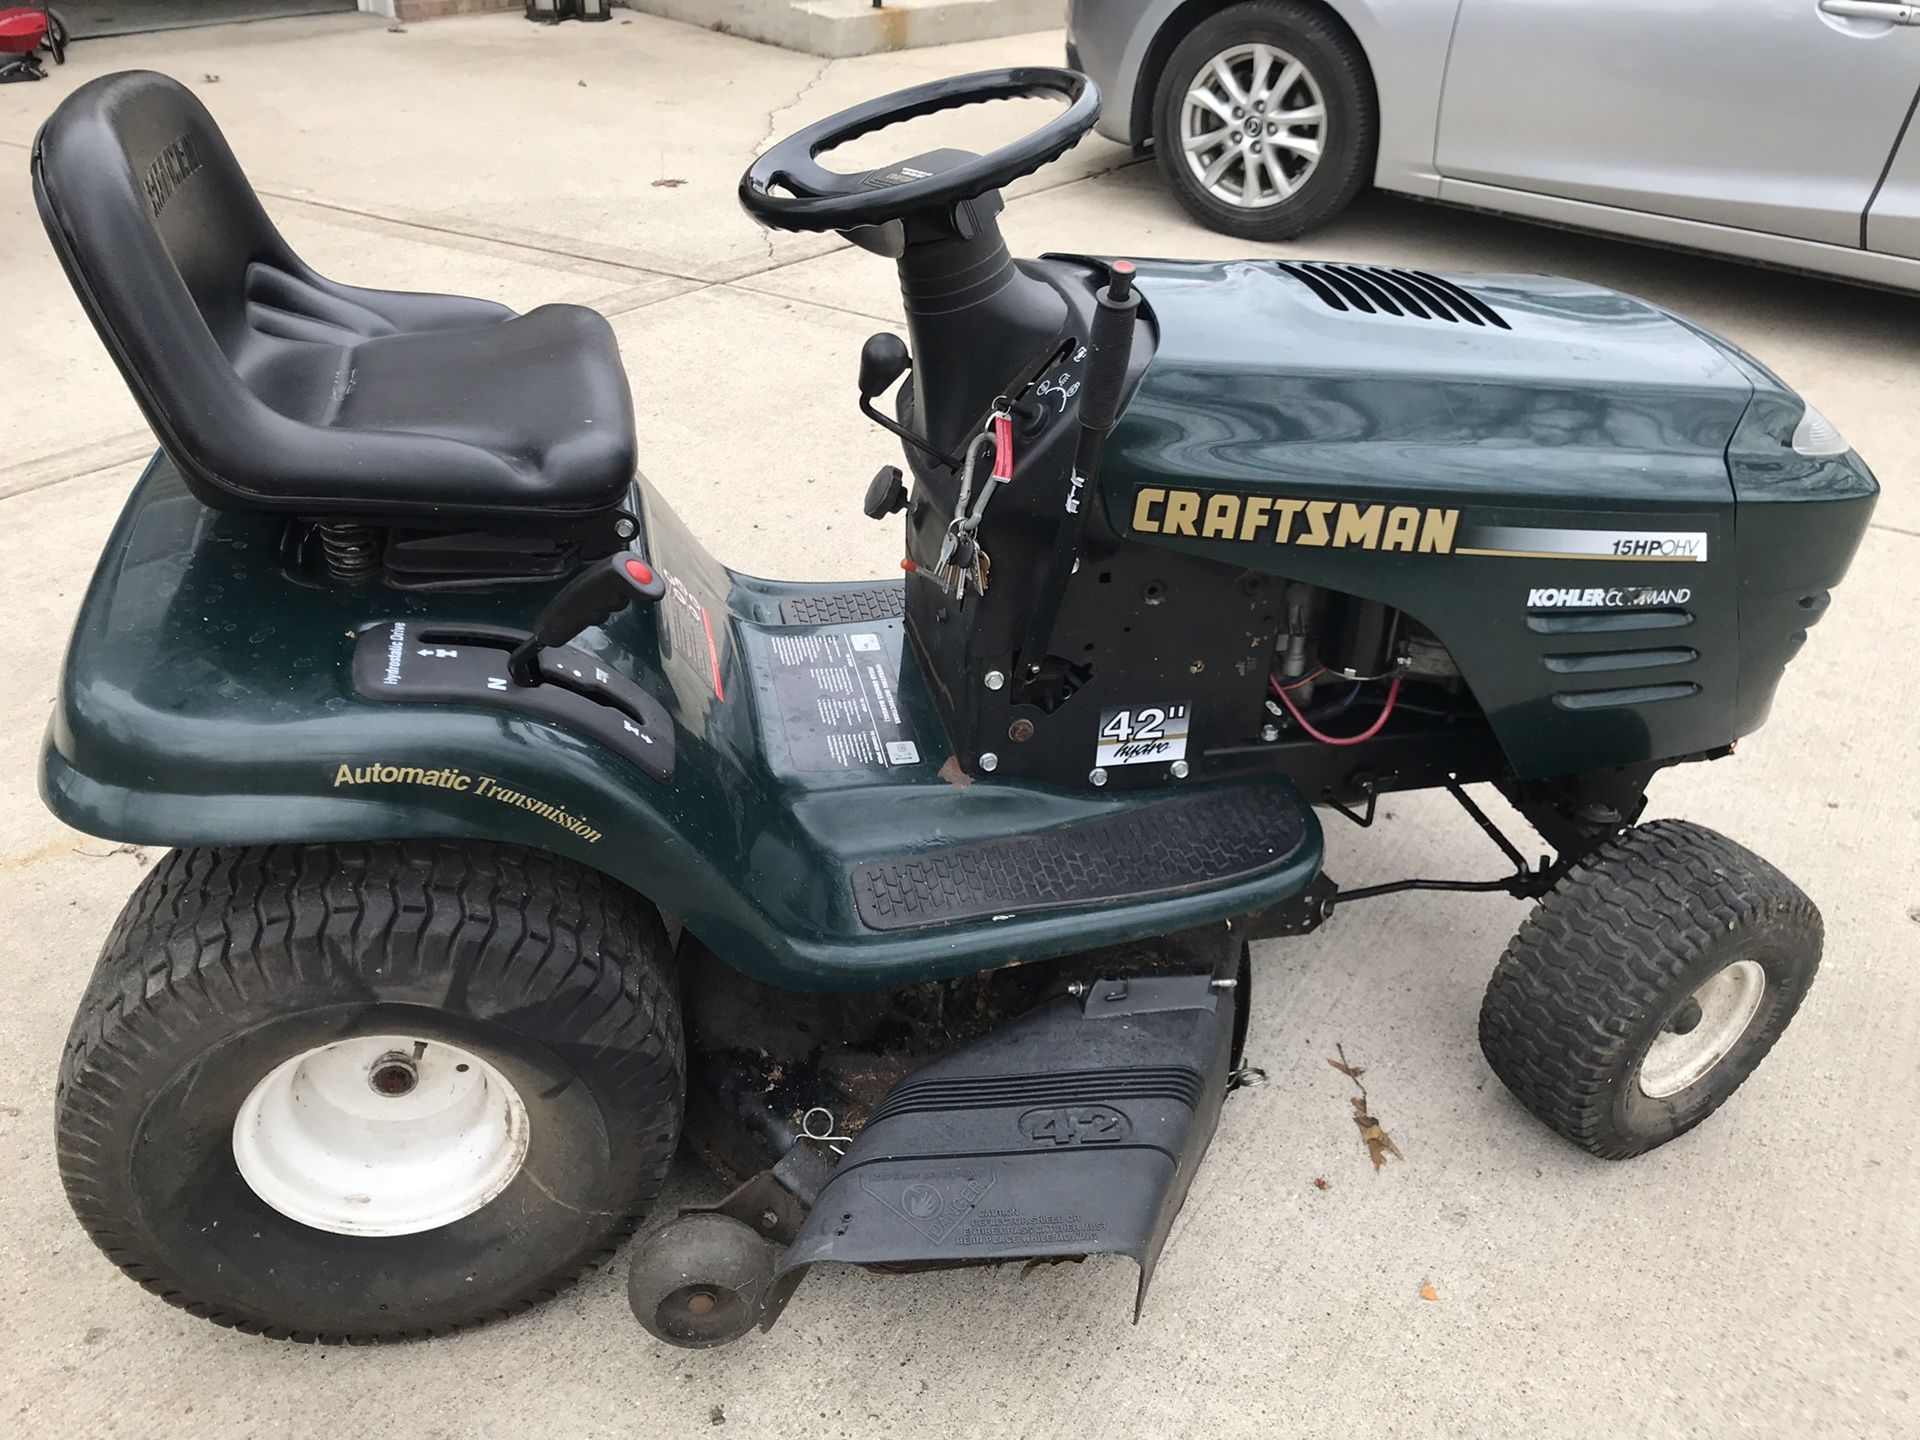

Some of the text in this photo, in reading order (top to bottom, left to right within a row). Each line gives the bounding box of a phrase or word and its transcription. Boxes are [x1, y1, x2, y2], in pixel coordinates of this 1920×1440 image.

[1132, 488, 1459, 554] CRAFTSMAN
[383, 622, 406, 685] Hydrostatic Drive
[487, 677, 508, 691] N
[1102, 704, 1185, 743] 42"
[1113, 740, 1169, 763] hydro
[334, 763, 603, 843] Automatic Transmission
[927, 1179, 985, 1238] DANGER
[977, 1208, 1019, 1218] CAUTION
[963, 1222, 1108, 1237] ENTIRE GRASS CATCHER MUST
[971, 1216, 1029, 1227] DEFLECTOR
[1030, 1216, 1063, 1226] SHIELD
[985, 1235, 1019, 1245] PLACE
[1021, 1234, 1053, 1244] WHILE
